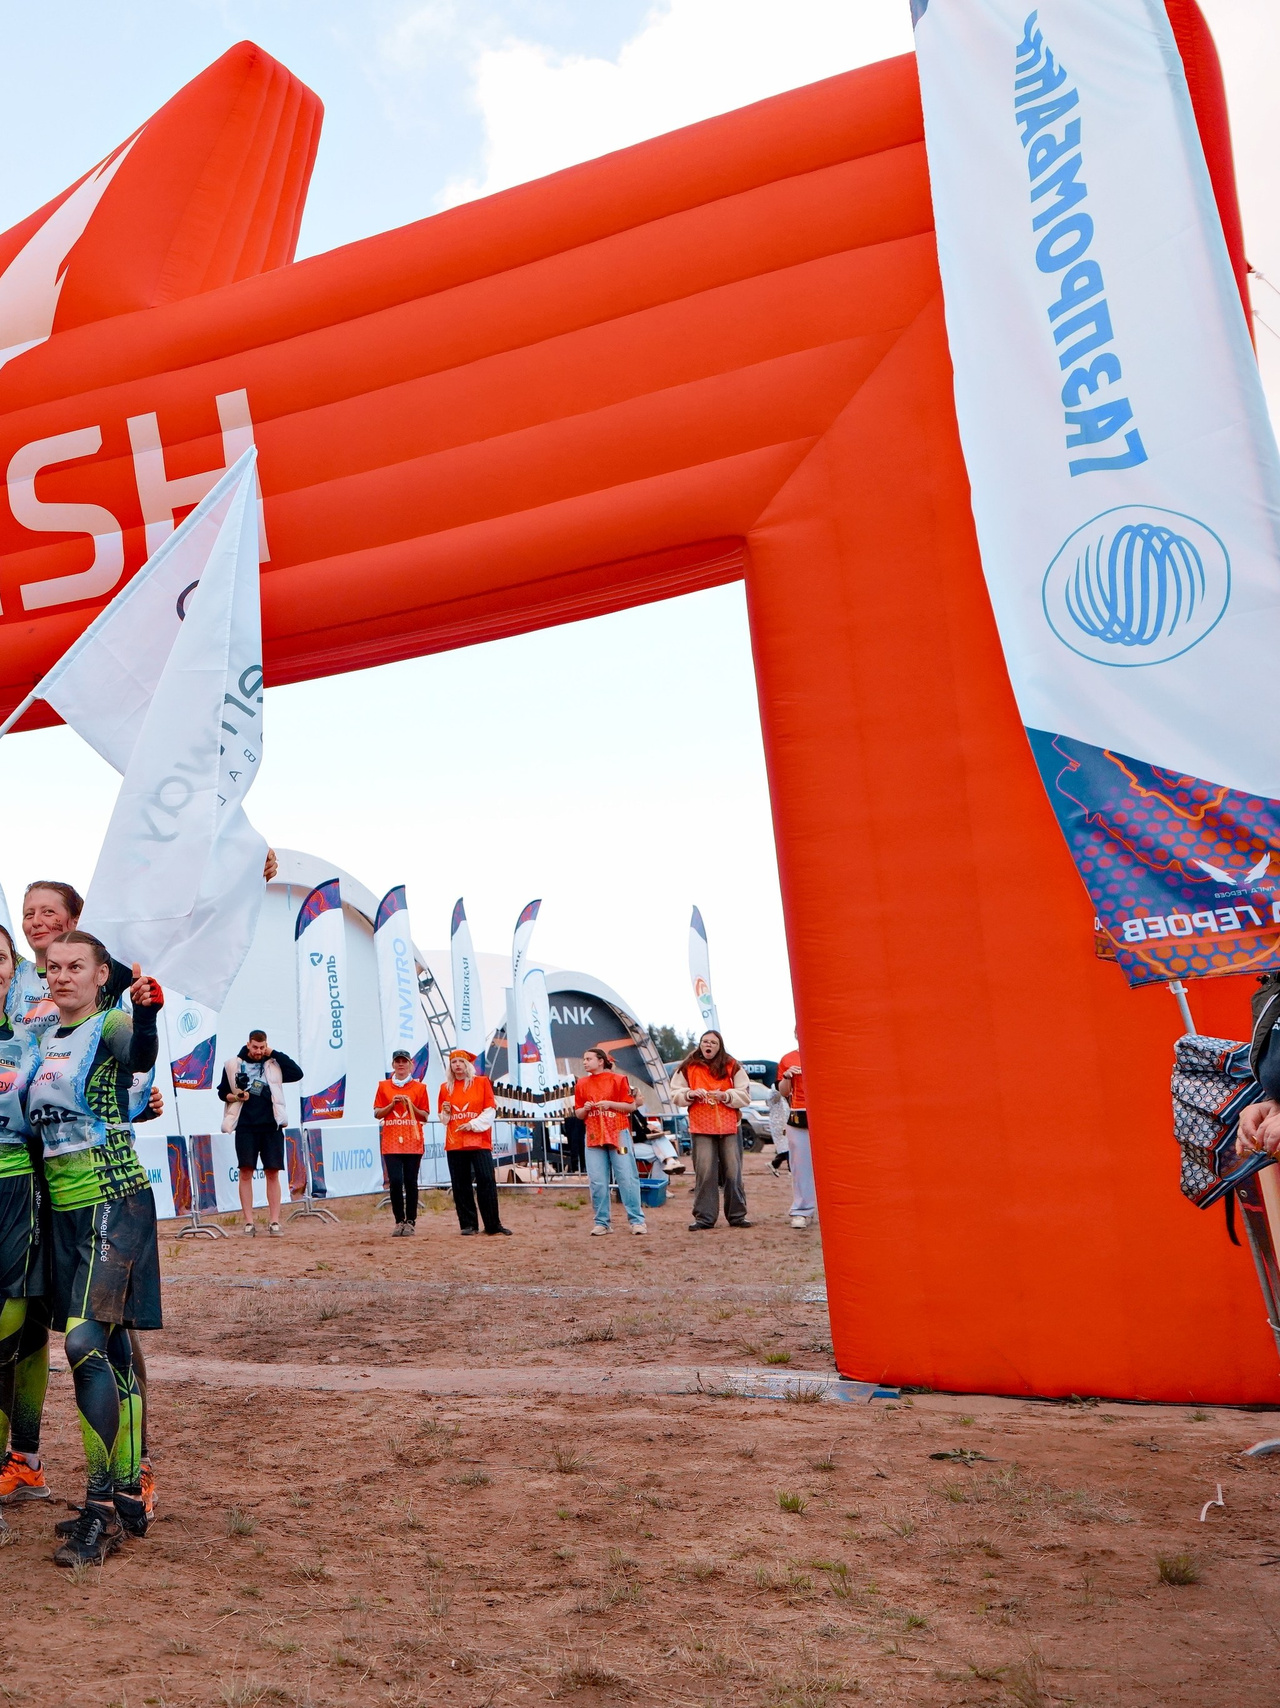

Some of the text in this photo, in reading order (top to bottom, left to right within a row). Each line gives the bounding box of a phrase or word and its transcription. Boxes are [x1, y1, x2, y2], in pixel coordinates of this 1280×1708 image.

[393, 938, 414, 1040] INVITRO
[326, 955, 344, 1049] Северсталь
[550, 1006, 594, 1025] ANK
[743, 1064, 767, 1073] РОЕВ
[332, 1148, 373, 1172] INVITRO
